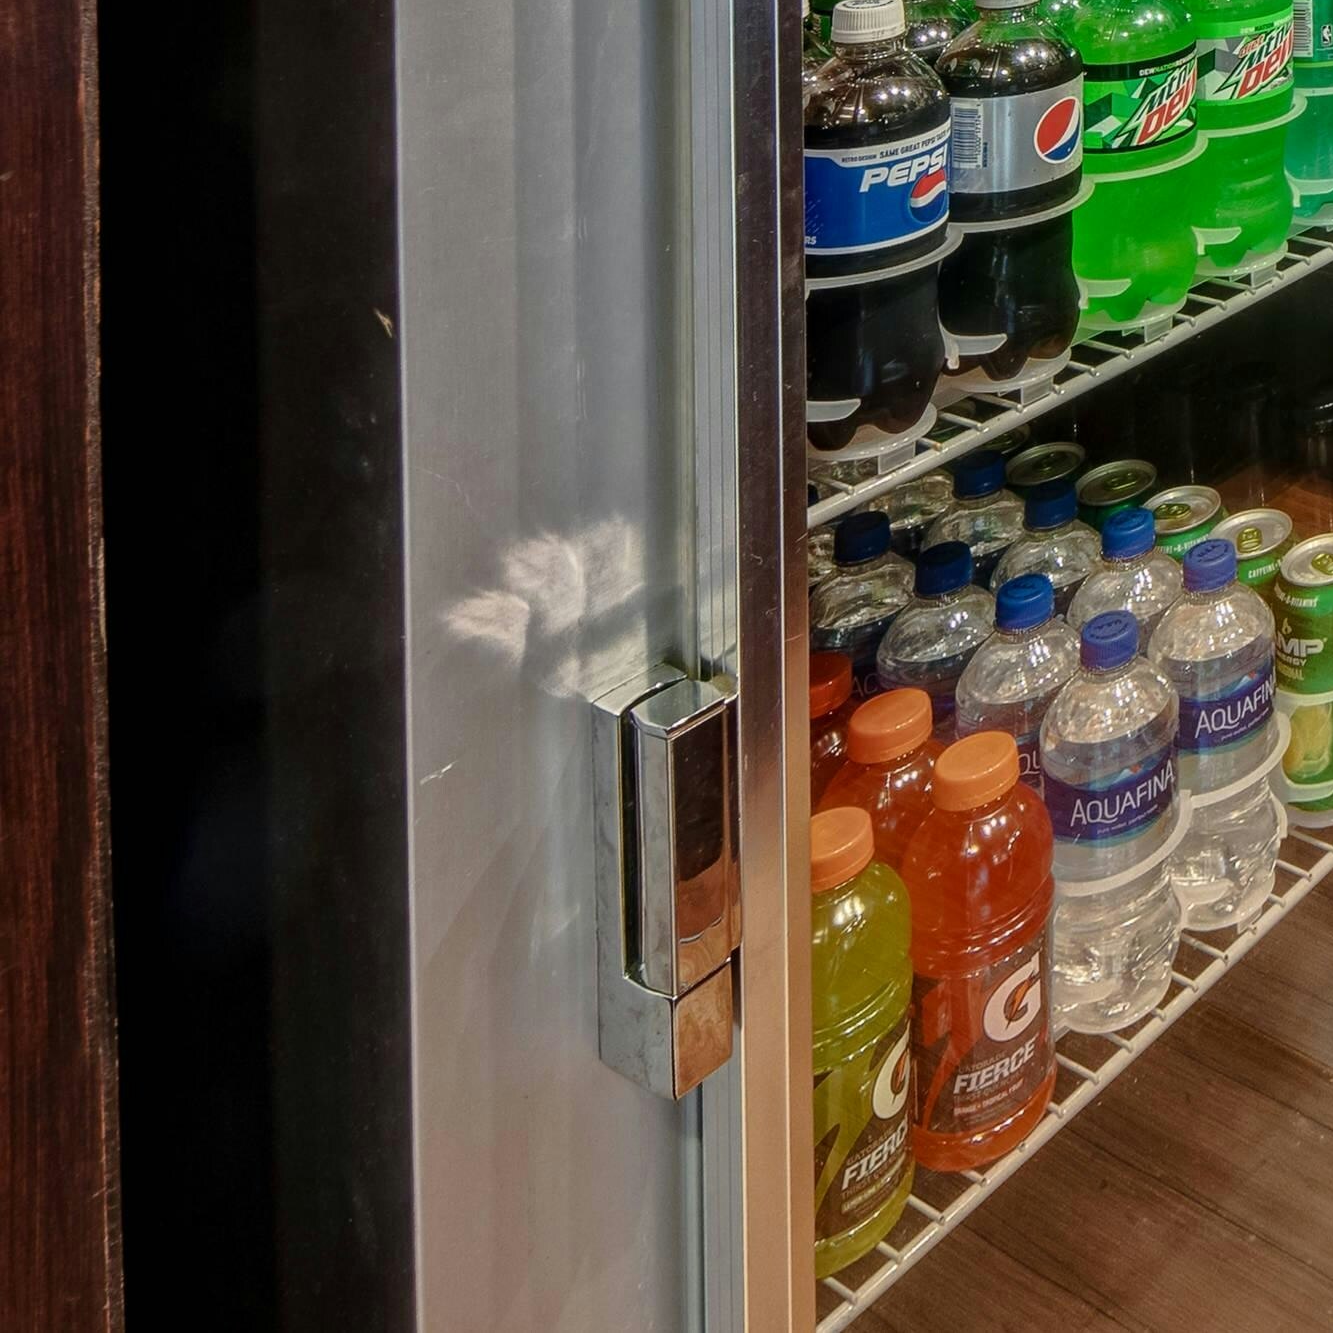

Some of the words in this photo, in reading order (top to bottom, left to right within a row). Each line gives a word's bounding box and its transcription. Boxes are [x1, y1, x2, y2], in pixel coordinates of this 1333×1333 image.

[859, 143, 948, 193] PEPSI
[879, 147, 898, 158] SAME
[900, 142, 920, 156] GREAT
[1195, 672, 1276, 739] AQUAFIN
[1070, 759, 1175, 827] AQUAFINA
[983, 950, 1041, 1042] G
[871, 1018, 911, 1120] G
[953, 1034, 1038, 1095] FIERCE
